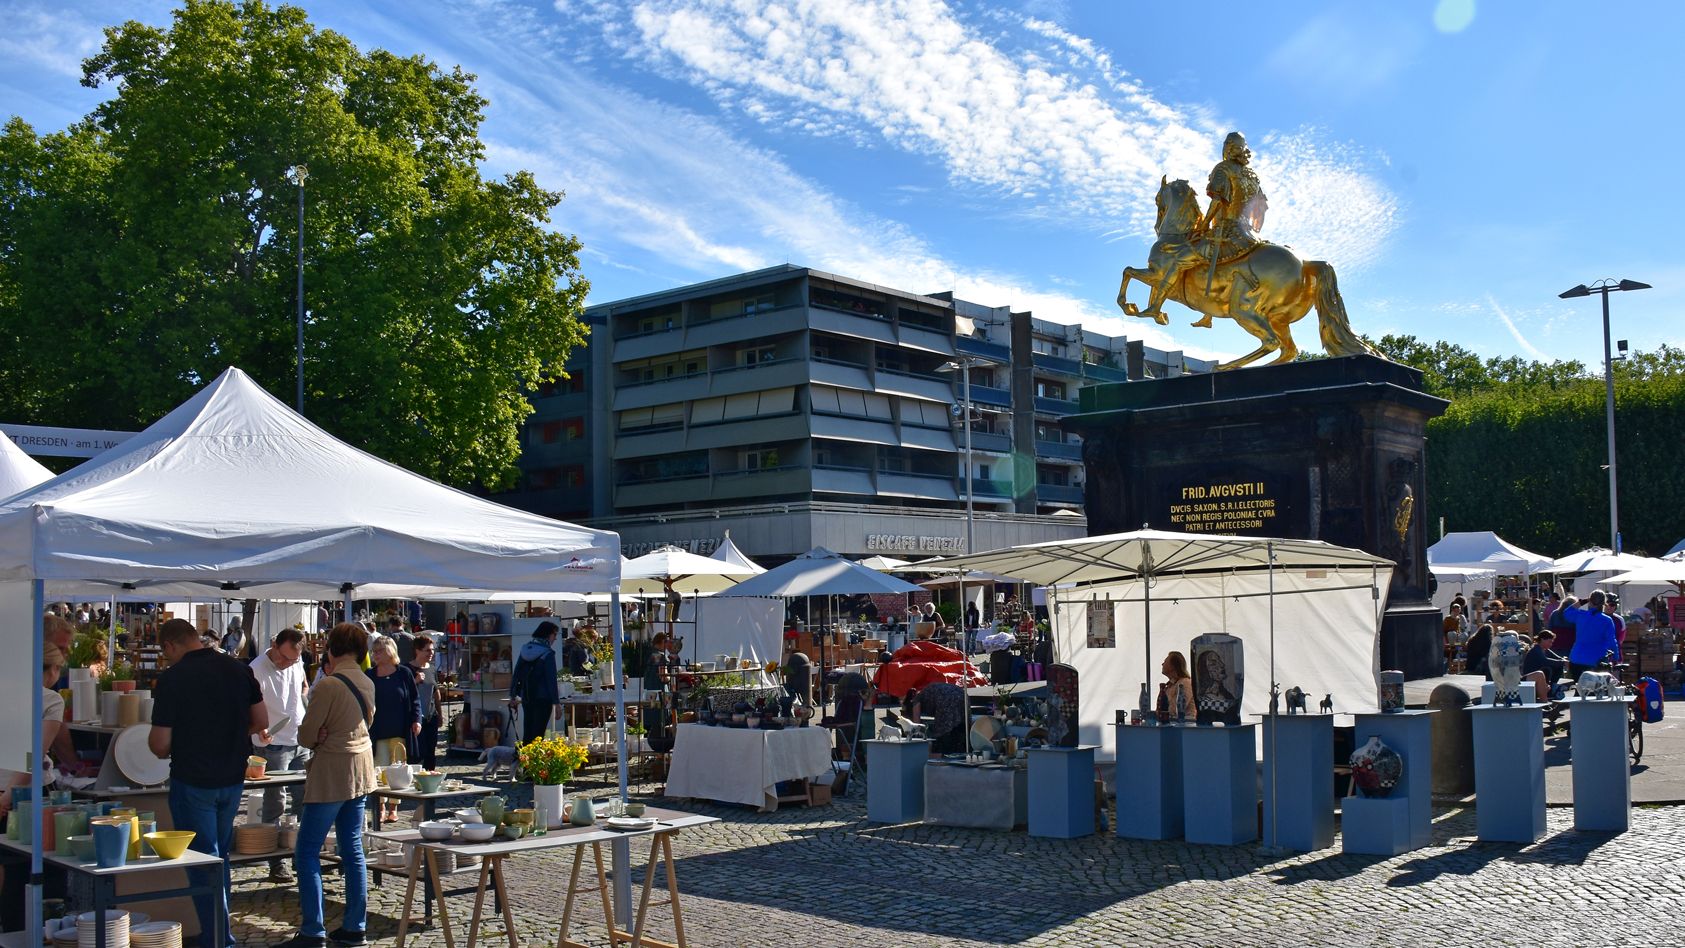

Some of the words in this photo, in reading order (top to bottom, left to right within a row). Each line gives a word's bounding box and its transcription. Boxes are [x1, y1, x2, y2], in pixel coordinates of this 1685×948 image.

[21, 435, 68, 447] DRESDEN
[75, 440, 91, 448] am
[1182, 486, 1208, 500] FRID.
[1209, 482, 1254, 498] AVGVSTI
[1256, 482, 1264, 495] II
[1170, 504, 1192, 513] DVCIS
[1193, 503, 1219, 512] SAXON.
[1171, 514, 1184, 523] NEC
[1186, 513, 1201, 522] NON
[1202, 512, 1222, 521] REGIS
[1223, 510, 1256, 520] POLONIAE
[1258, 509, 1275, 518] CVRA
[1185, 523, 1204, 531] PATRI
[1205, 522, 1214, 531] ET
[1215, 520, 1262, 530] ANTECESSORI
[919, 535, 965, 551] VENEZIA
